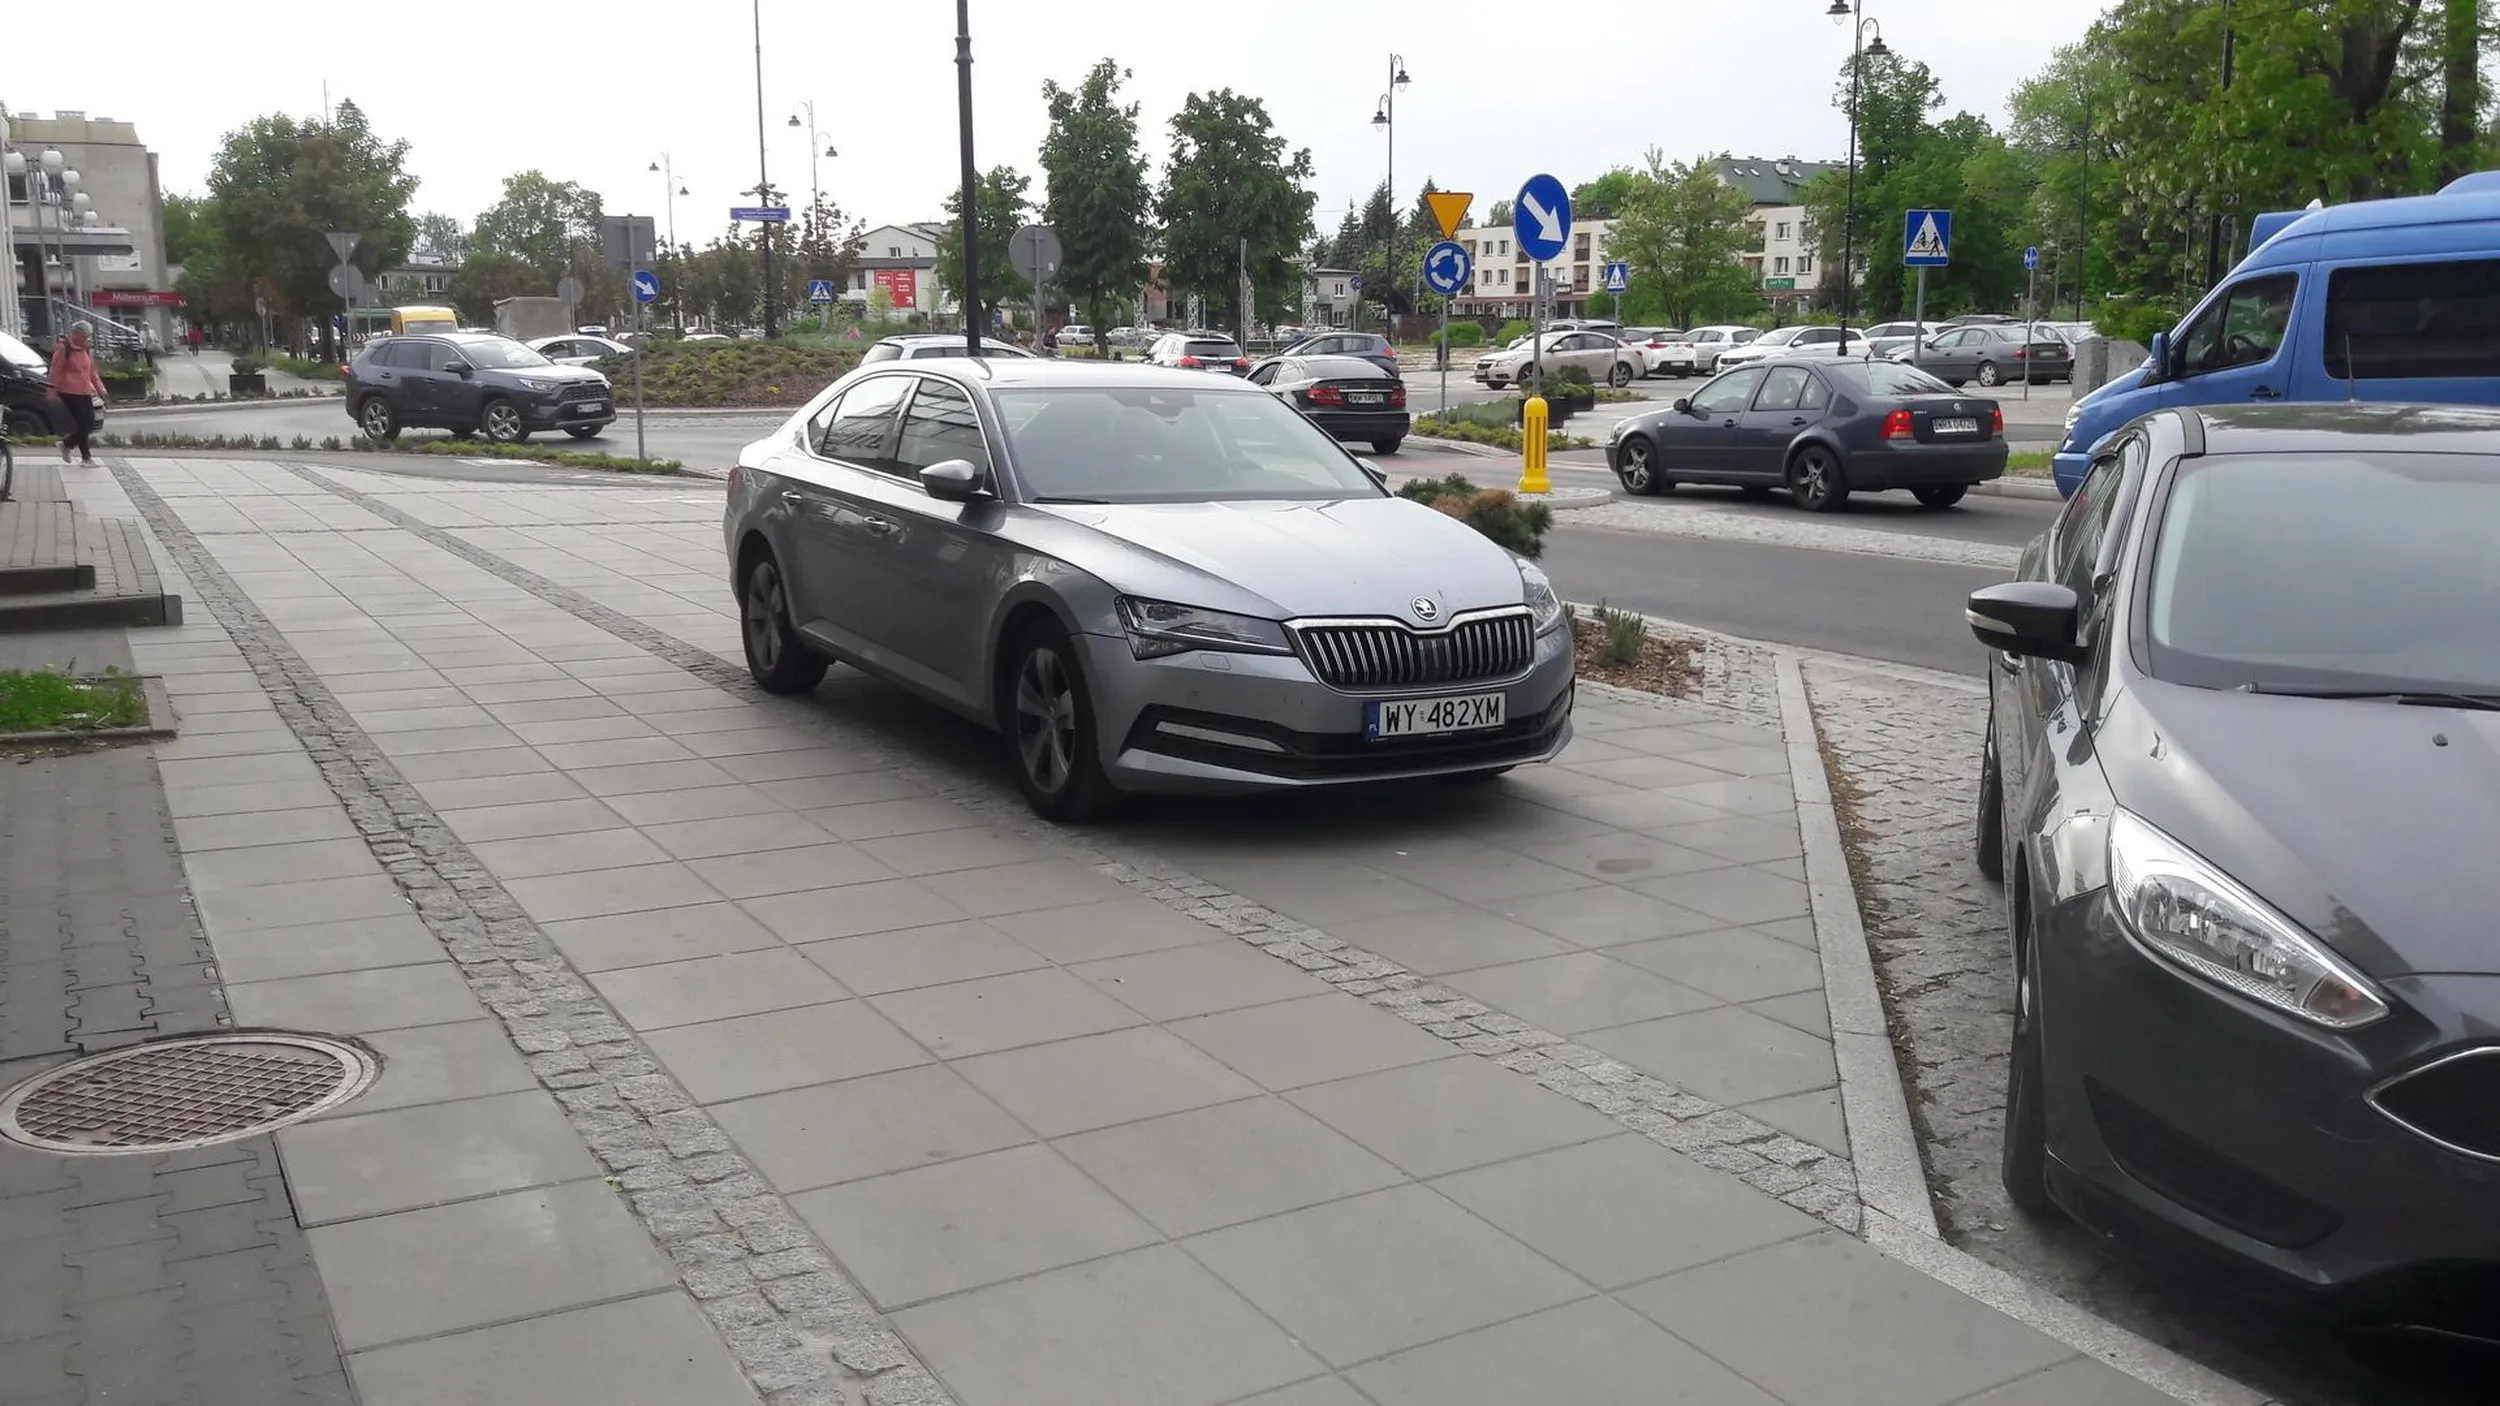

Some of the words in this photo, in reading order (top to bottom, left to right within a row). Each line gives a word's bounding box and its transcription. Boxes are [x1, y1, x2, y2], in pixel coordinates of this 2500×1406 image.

[112, 291, 160, 302] Millennium
[1386, 704, 1417, 733] WY
[1427, 696, 1500, 730] 482XM
